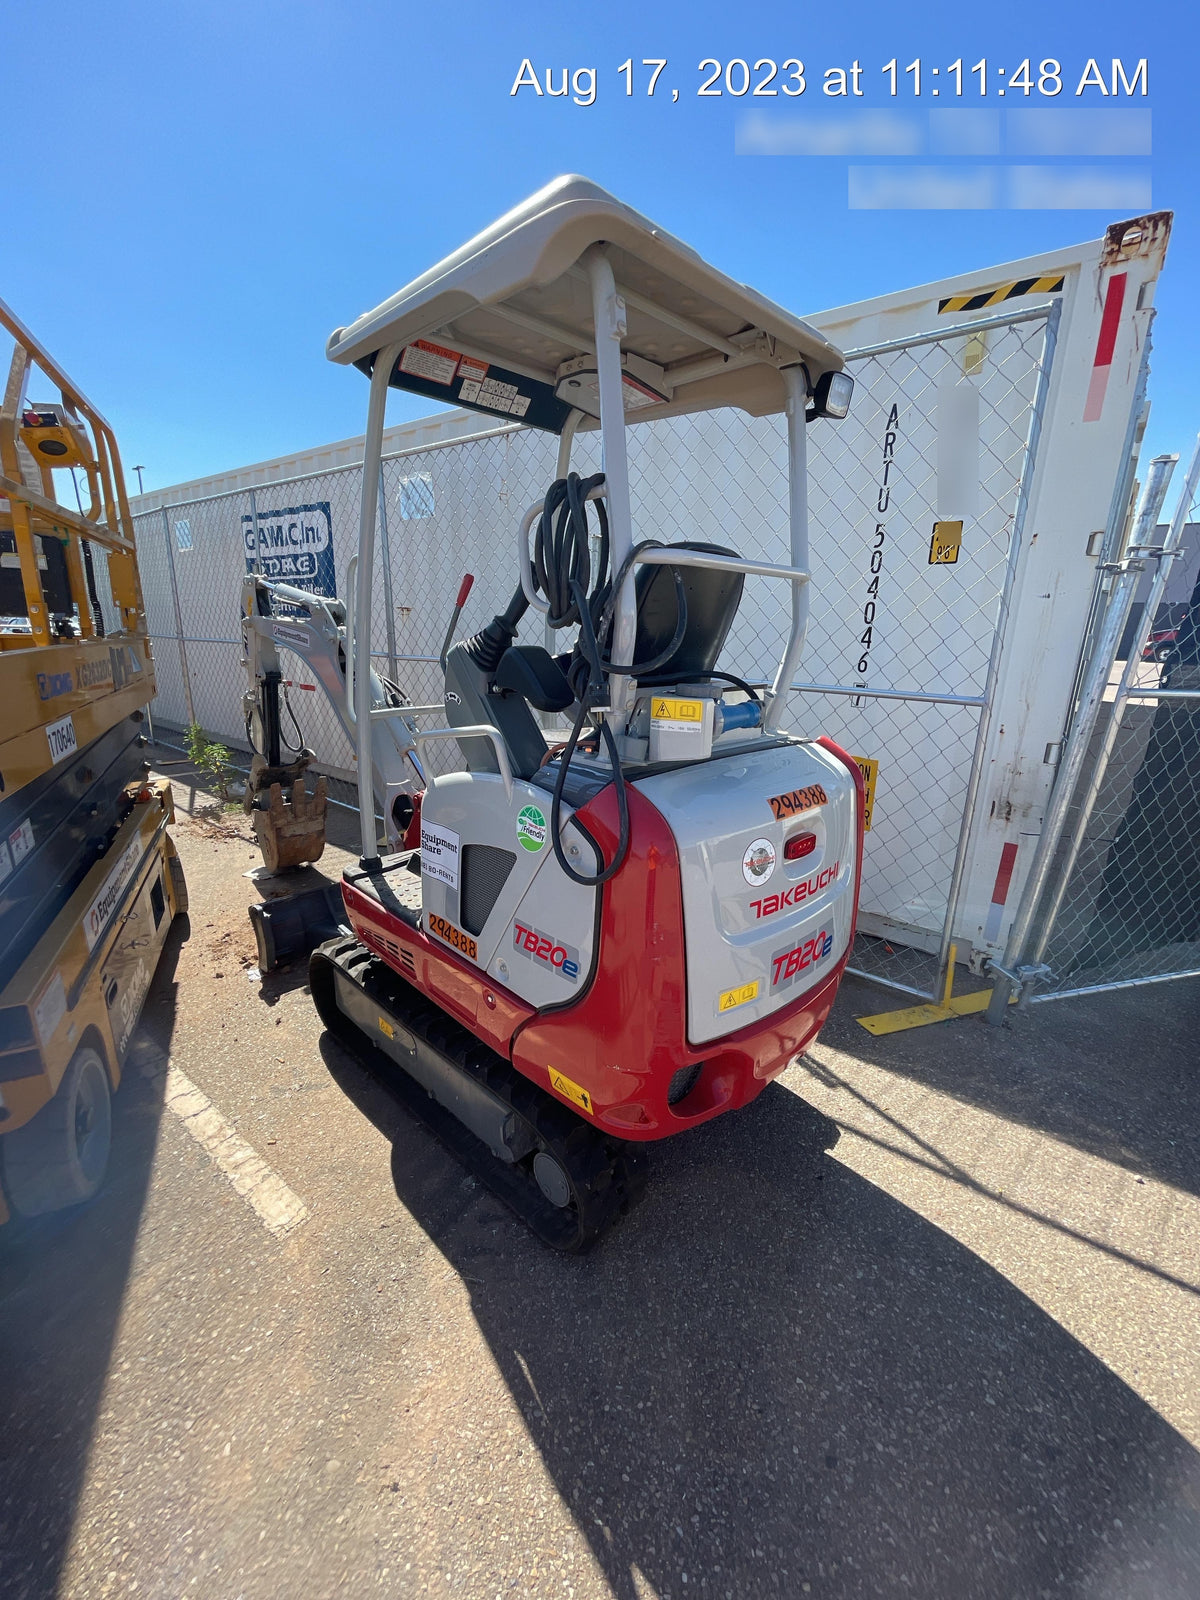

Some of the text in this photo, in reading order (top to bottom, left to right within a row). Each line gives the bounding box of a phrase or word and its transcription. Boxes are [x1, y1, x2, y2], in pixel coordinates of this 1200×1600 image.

[877, 403, 899, 513] ARTU
[857, 523, 885, 673] 504046
[771, 784, 828, 820] 294388
[421, 829, 458, 854] Equipment
[749, 861, 840, 919] TAKEUCHI
[429, 913, 477, 959] 294388
[515, 923, 578, 979] TB20e
[772, 930, 833, 986] TB20e
